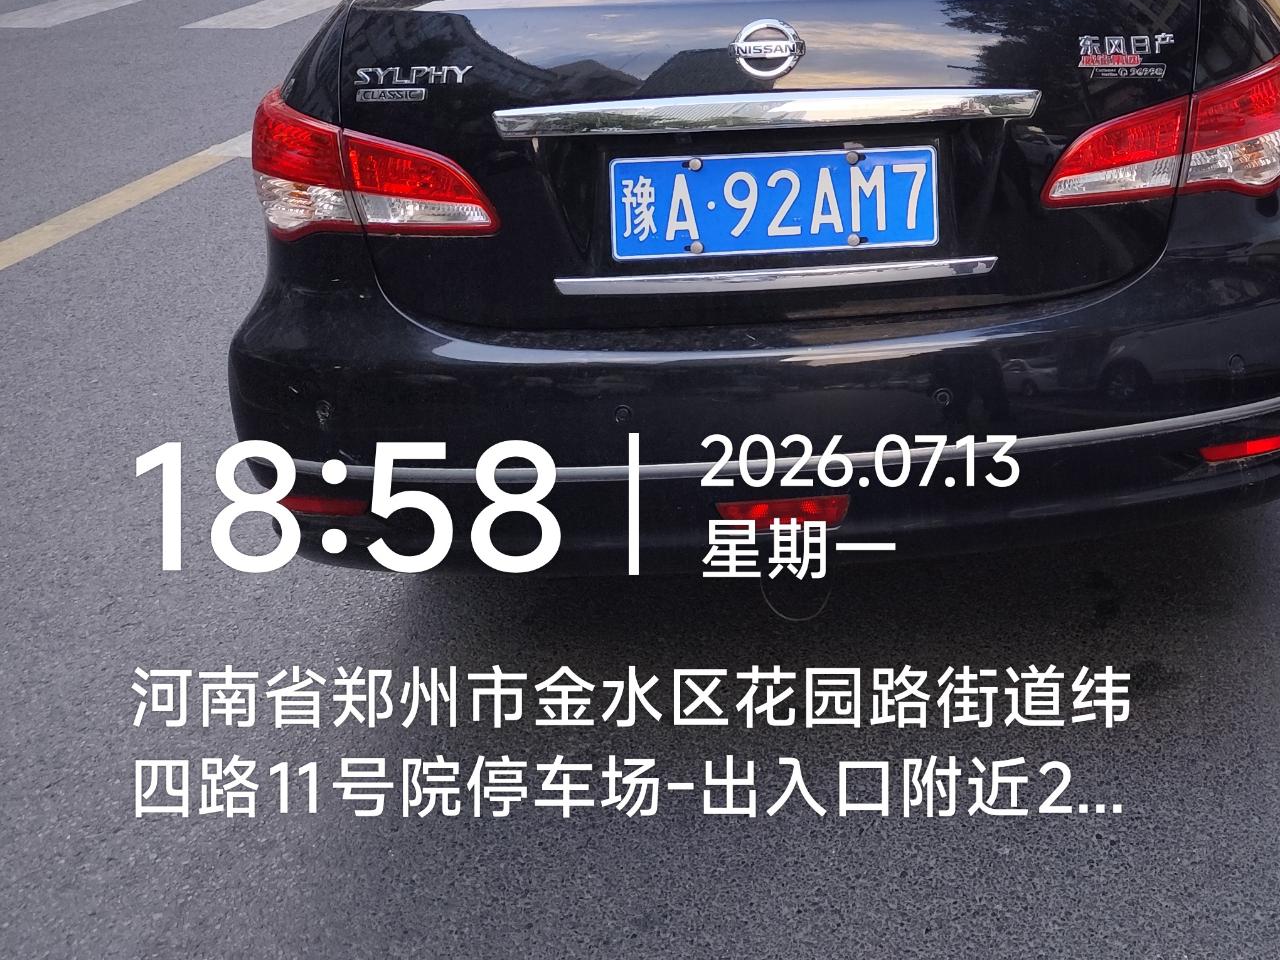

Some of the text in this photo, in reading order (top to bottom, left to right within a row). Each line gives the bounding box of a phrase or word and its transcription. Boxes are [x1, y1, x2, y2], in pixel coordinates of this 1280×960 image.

[736, 44, 795, 55] NISSAN
[1079, 33, 1174, 55] 东风日产
[354, 66, 473, 85] SYLPHY
[363, 90, 419, 100] CLASSIC
[621, 163, 927, 242] 豫A·92AM7
